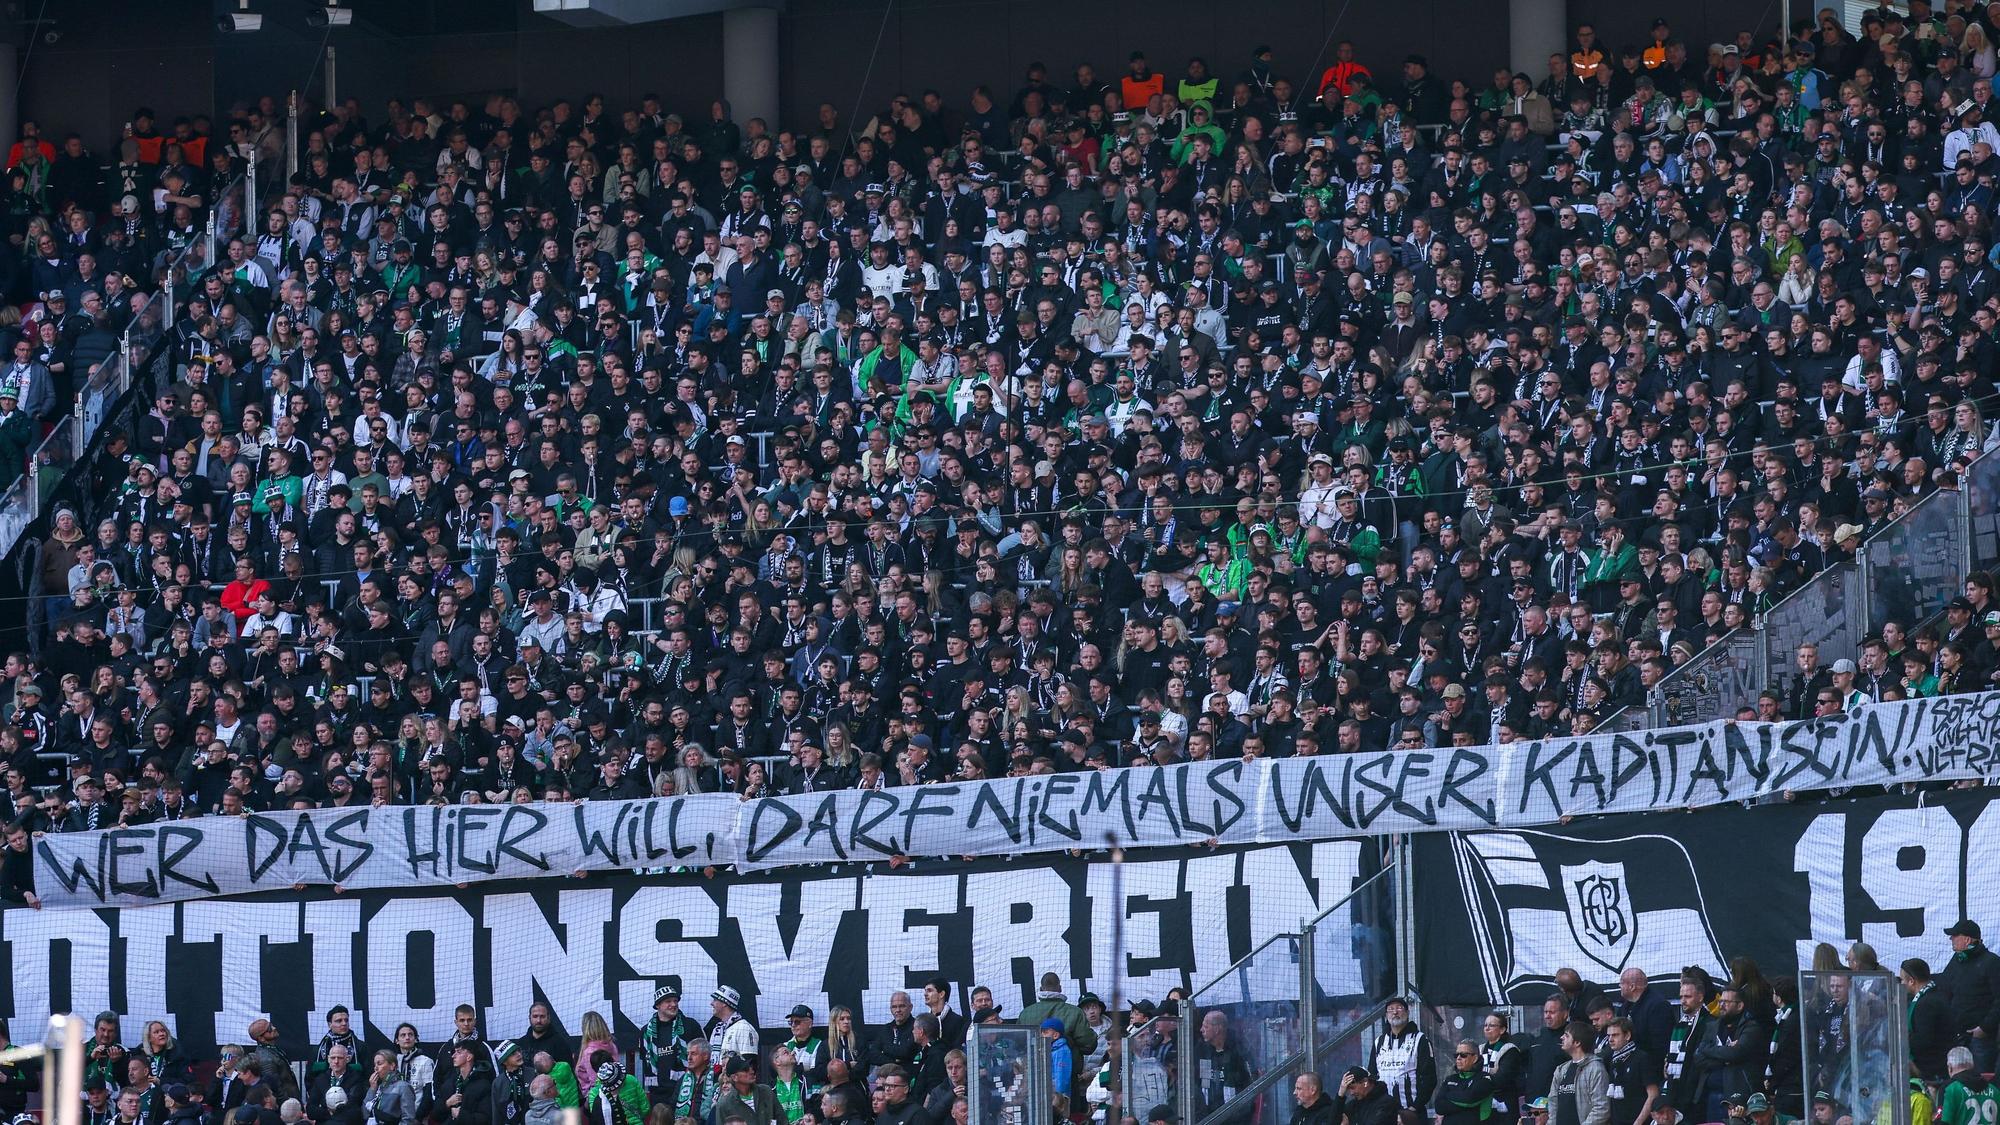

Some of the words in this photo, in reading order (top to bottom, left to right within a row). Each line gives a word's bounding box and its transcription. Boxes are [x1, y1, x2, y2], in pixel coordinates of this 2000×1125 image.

[37, 826, 219, 903] WER
[246, 809, 375, 884] DAS
[747, 786, 959, 862] DARF
[1271, 748, 1497, 833] UNSER
[1965, 1098, 1998, 1125] 29
